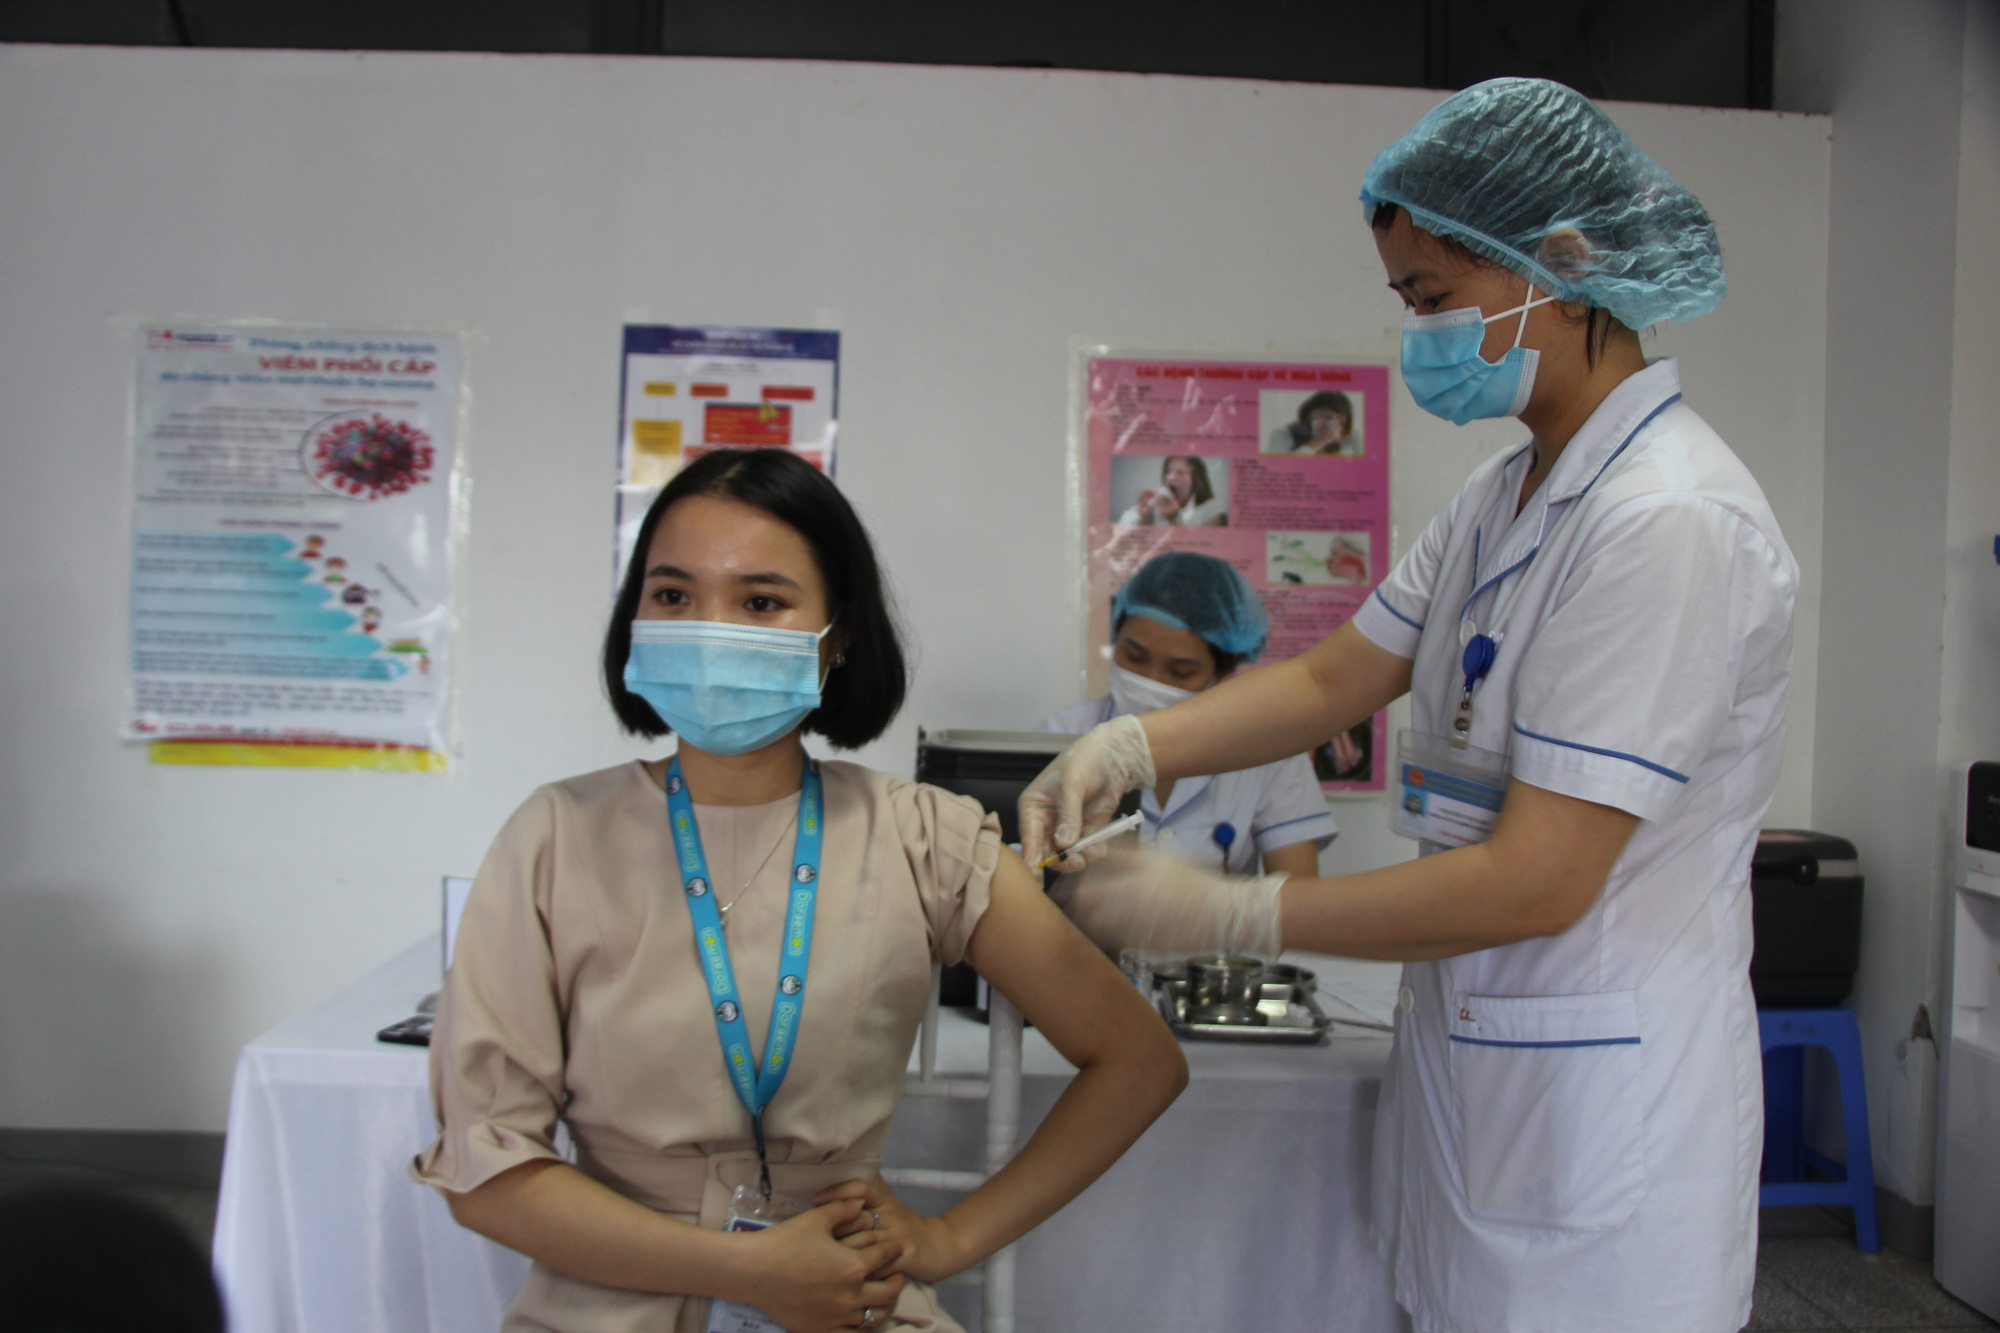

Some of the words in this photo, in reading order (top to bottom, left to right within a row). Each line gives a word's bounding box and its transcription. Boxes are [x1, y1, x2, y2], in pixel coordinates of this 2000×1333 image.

[674, 810, 699, 873] Doraemon
[789, 889, 812, 956] Doraemon
[701, 927, 731, 994] Doraemon
[768, 1001, 796, 1074] Doraemon
